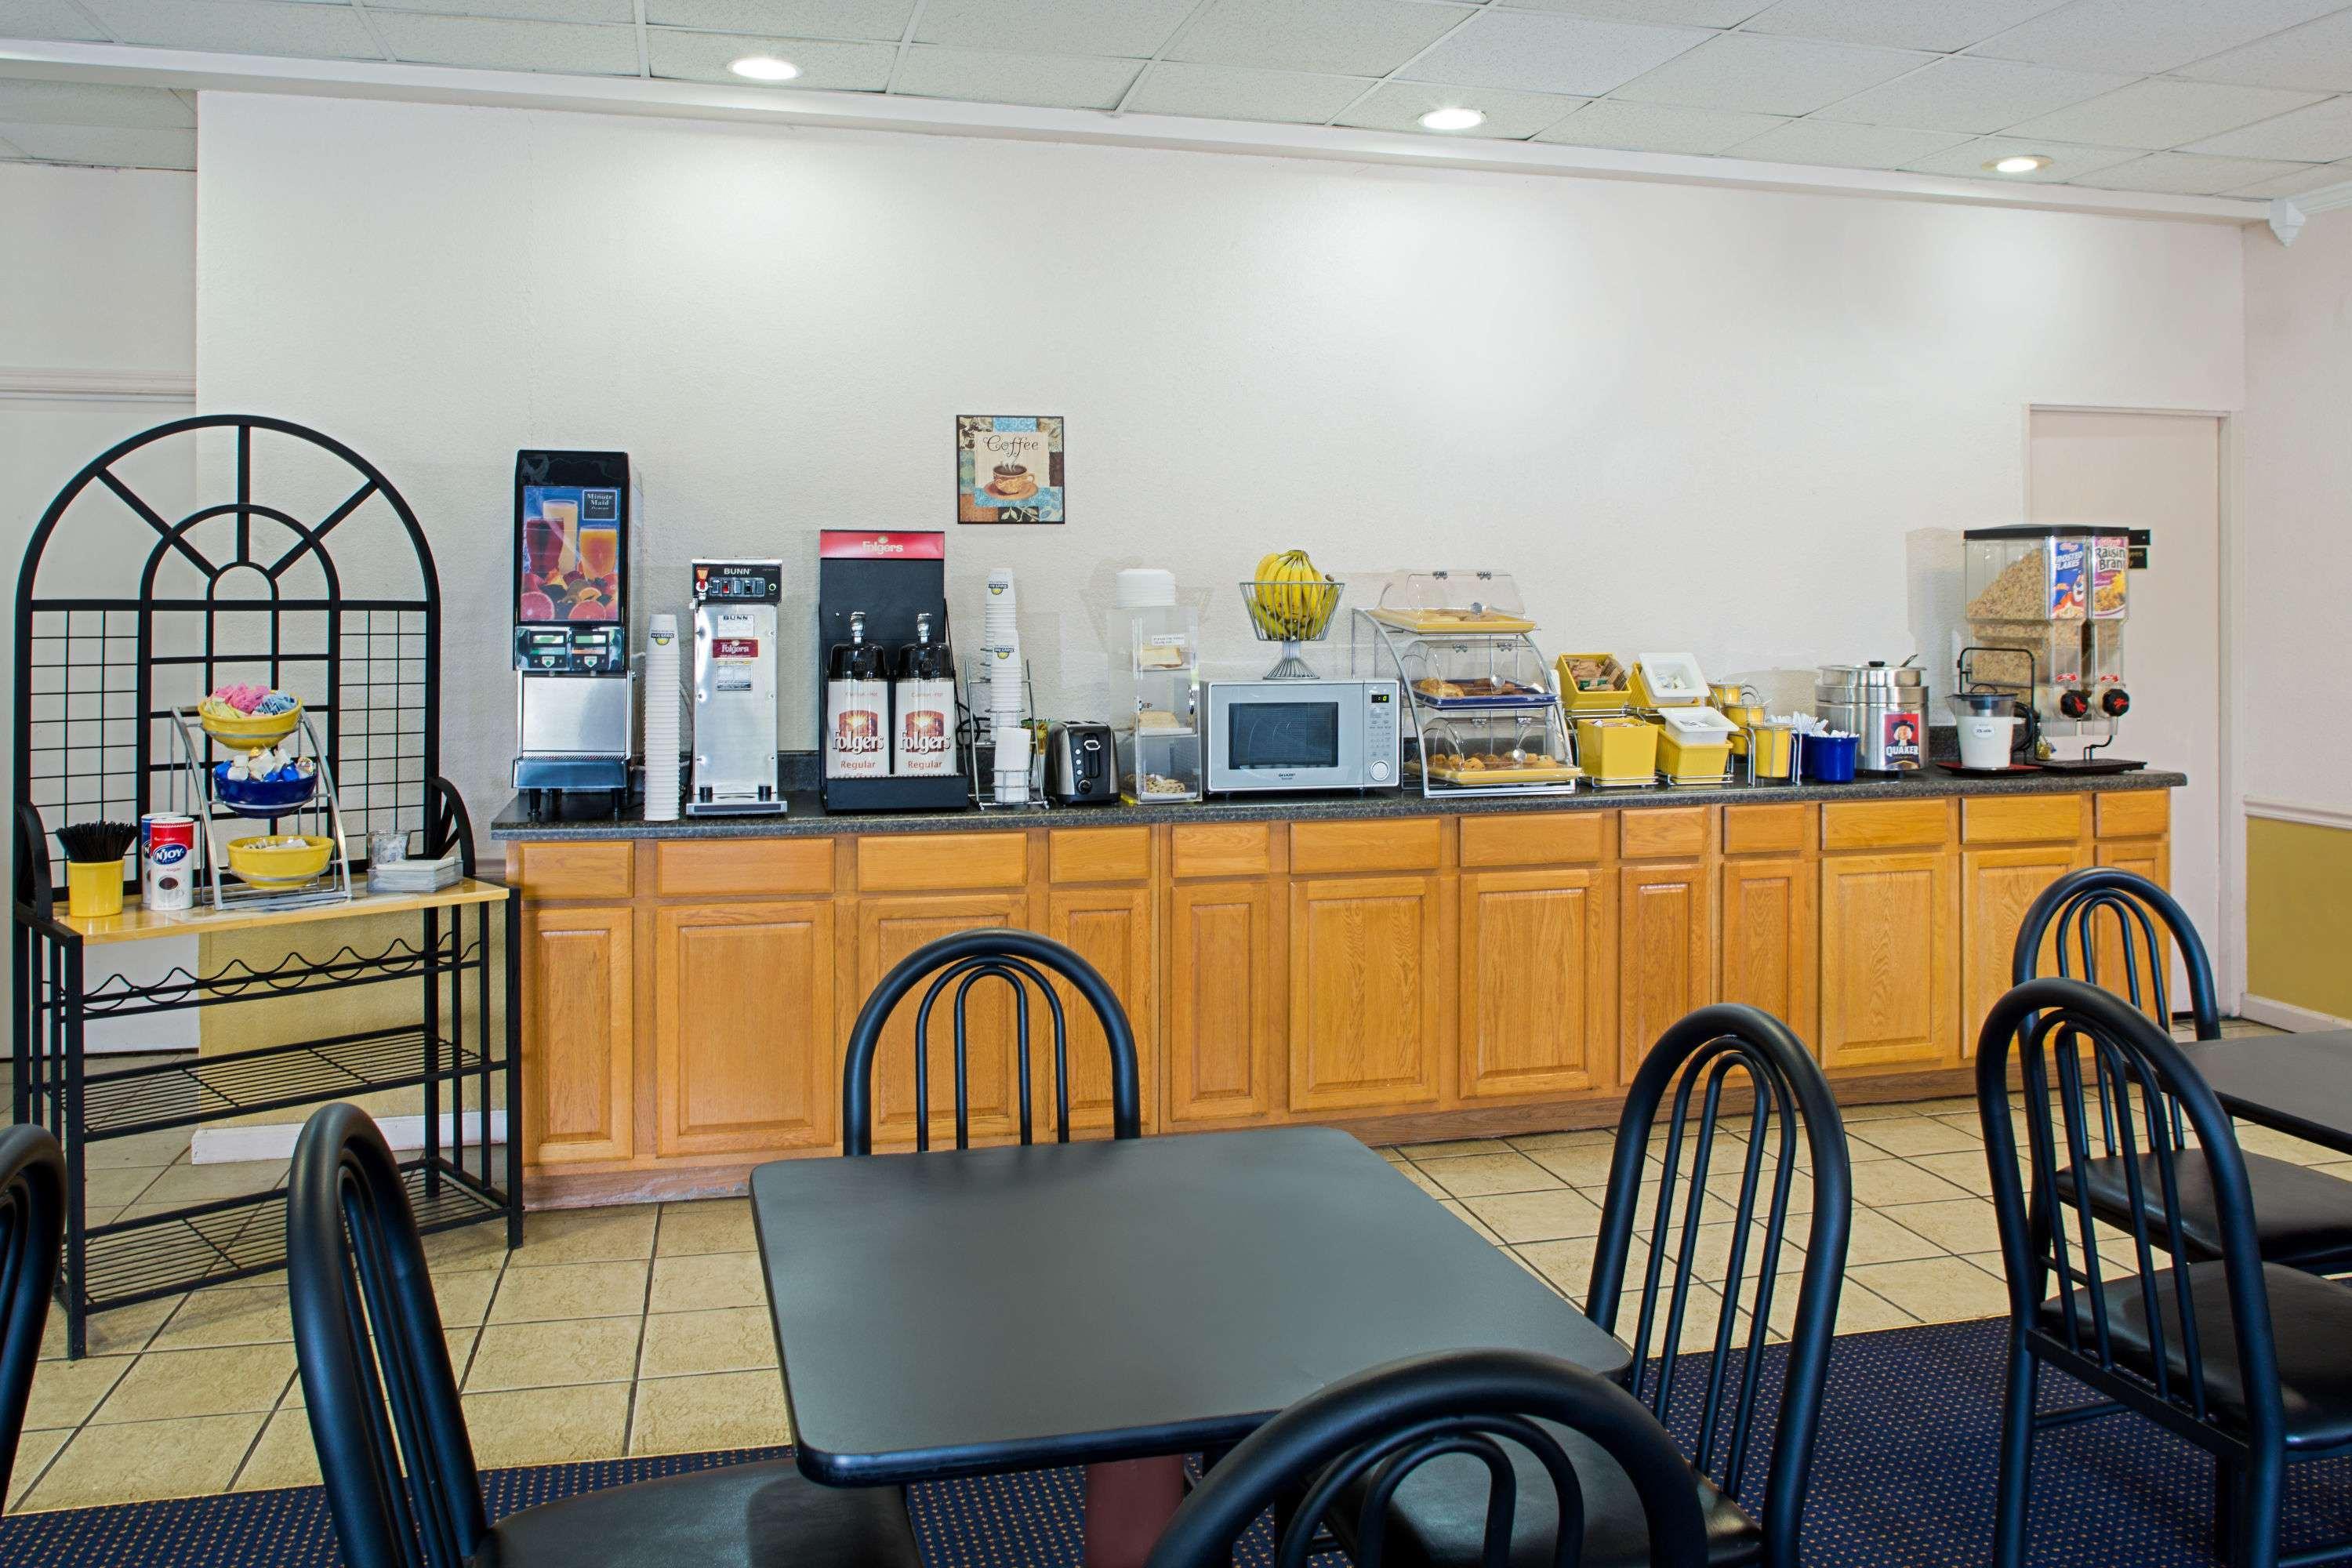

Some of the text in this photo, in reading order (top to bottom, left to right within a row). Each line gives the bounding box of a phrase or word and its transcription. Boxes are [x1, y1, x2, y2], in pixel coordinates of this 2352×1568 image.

[983, 434, 1039, 457] Coffee
[862, 541, 903, 555] Folgers
[2096, 547, 2125, 558] Raisin
[2100, 559, 2123, 570] Bran
[832, 729, 884, 754] Folgers
[899, 729, 952, 754] Folgers
[1886, 746, 1918, 757] QUAKER
[840, 760, 876, 771] Regular
[908, 760, 943, 771] Regular
